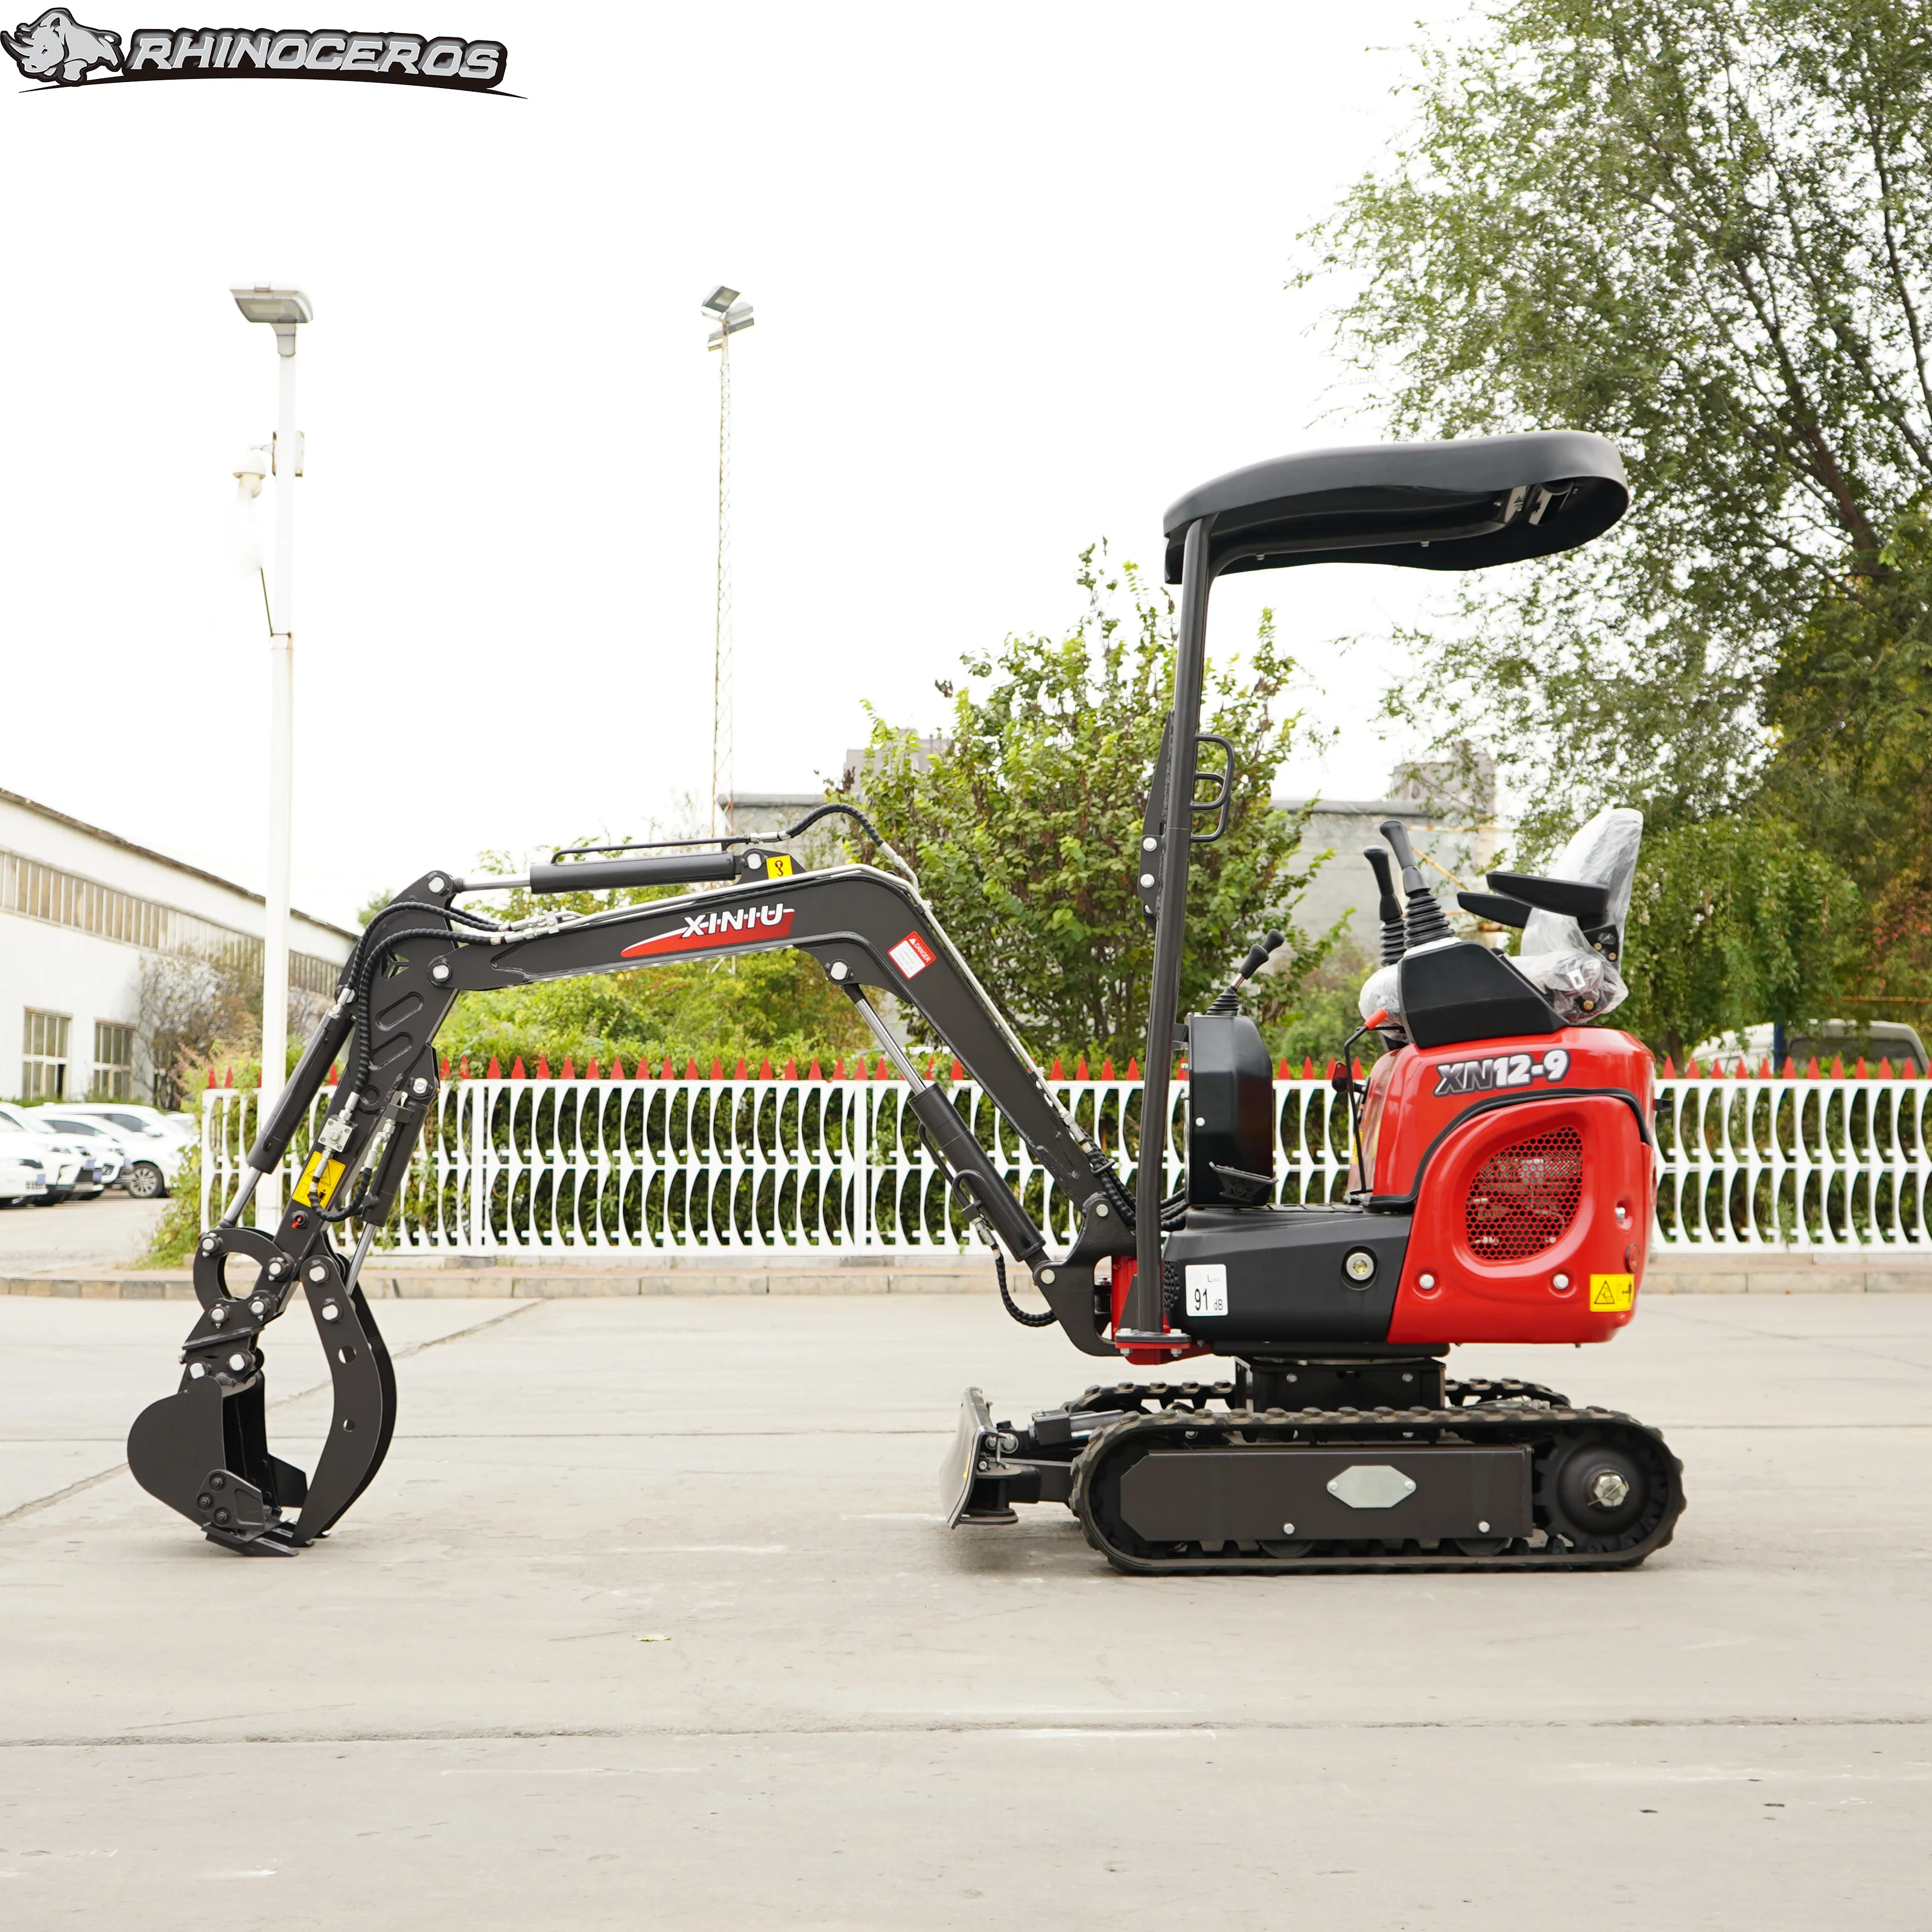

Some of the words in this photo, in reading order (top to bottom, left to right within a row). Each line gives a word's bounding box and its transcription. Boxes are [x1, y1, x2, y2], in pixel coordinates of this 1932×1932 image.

[681, 903, 784, 938] XINIU
[914, 942, 931, 962] DANGER
[1434, 1049, 1570, 1096] XN12-9
[1195, 1288, 1208, 1311] 91
[1214, 1299, 1223, 1311] dB
